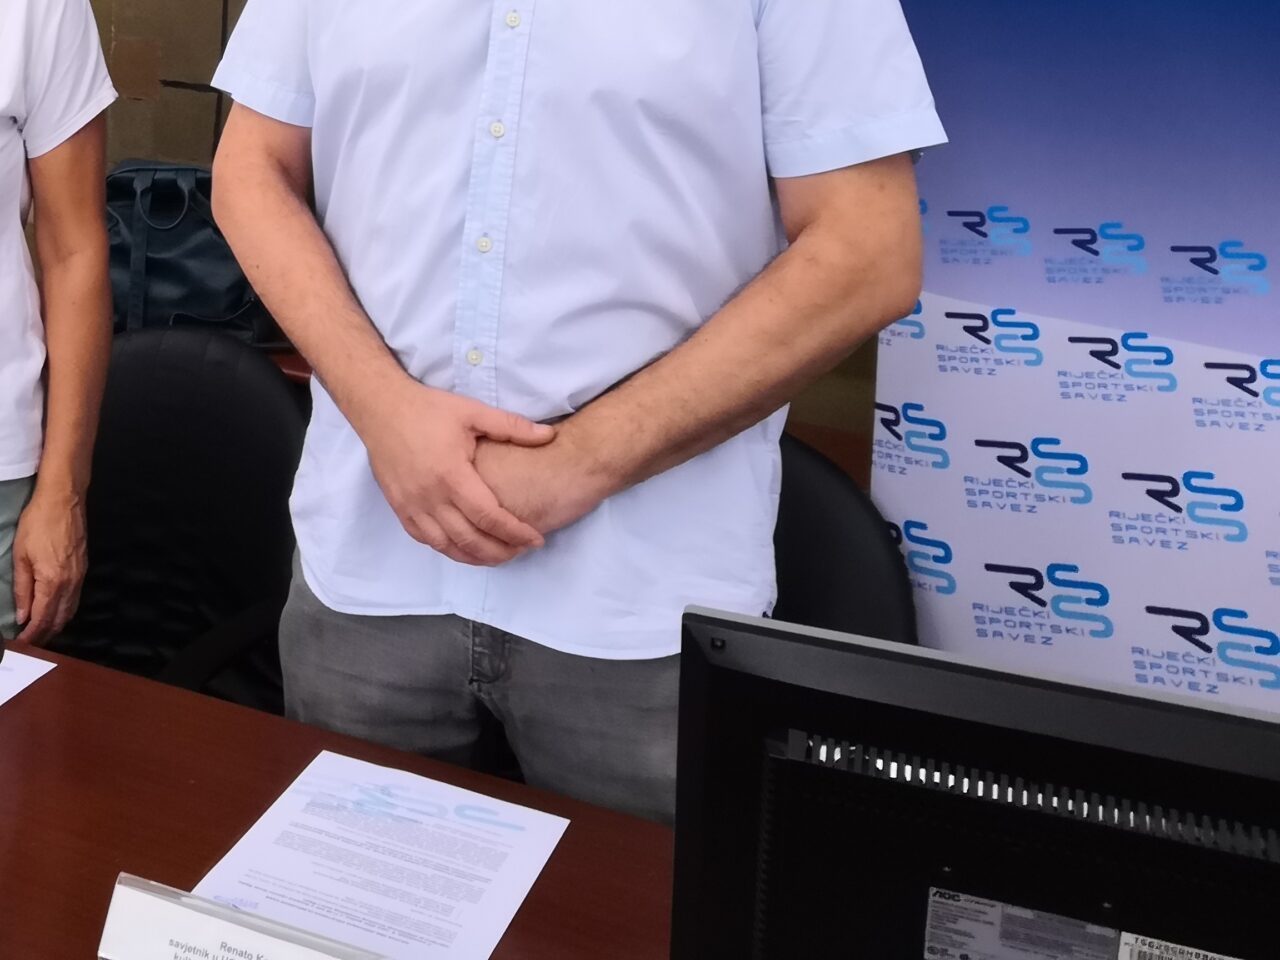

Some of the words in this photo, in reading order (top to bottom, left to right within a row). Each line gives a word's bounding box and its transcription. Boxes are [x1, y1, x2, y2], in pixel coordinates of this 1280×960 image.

[935, 343, 995, 355] RIJEČKI
[937, 354, 1021, 366] SPORTSKI
[938, 364, 998, 376] SAVEZ
[1057, 369, 1124, 381] RIJEČKI
[1059, 380, 1154, 393] SPORTSKI
[1060, 391, 1128, 403] SAVEZ
[1192, 396, 1264, 409] RIJEČKI
[1195, 419, 1267, 432] SAVEZ
[963, 475, 1035, 490] RIJEČKI
[964, 487, 1066, 504] SPORTSKI
[966, 499, 1038, 514] SAVEZ
[1108, 510, 1187, 525] RIJEČKI
[1110, 522, 1221, 541] SPORTSKI
[1111, 535, 1190, 551] SAVEZ
[972, 602, 1051, 620] RIJEČKI
[974, 615, 1085, 637] SPORTSKI
[976, 628, 1054, 646] SAVEZ
[1131, 646, 1217, 667] RIJEČKI
[1133, 660, 1254, 686] SPORTSKI
[1135, 673, 1220, 695] SAVEZ
[168, 938, 210, 959] savjetnik
